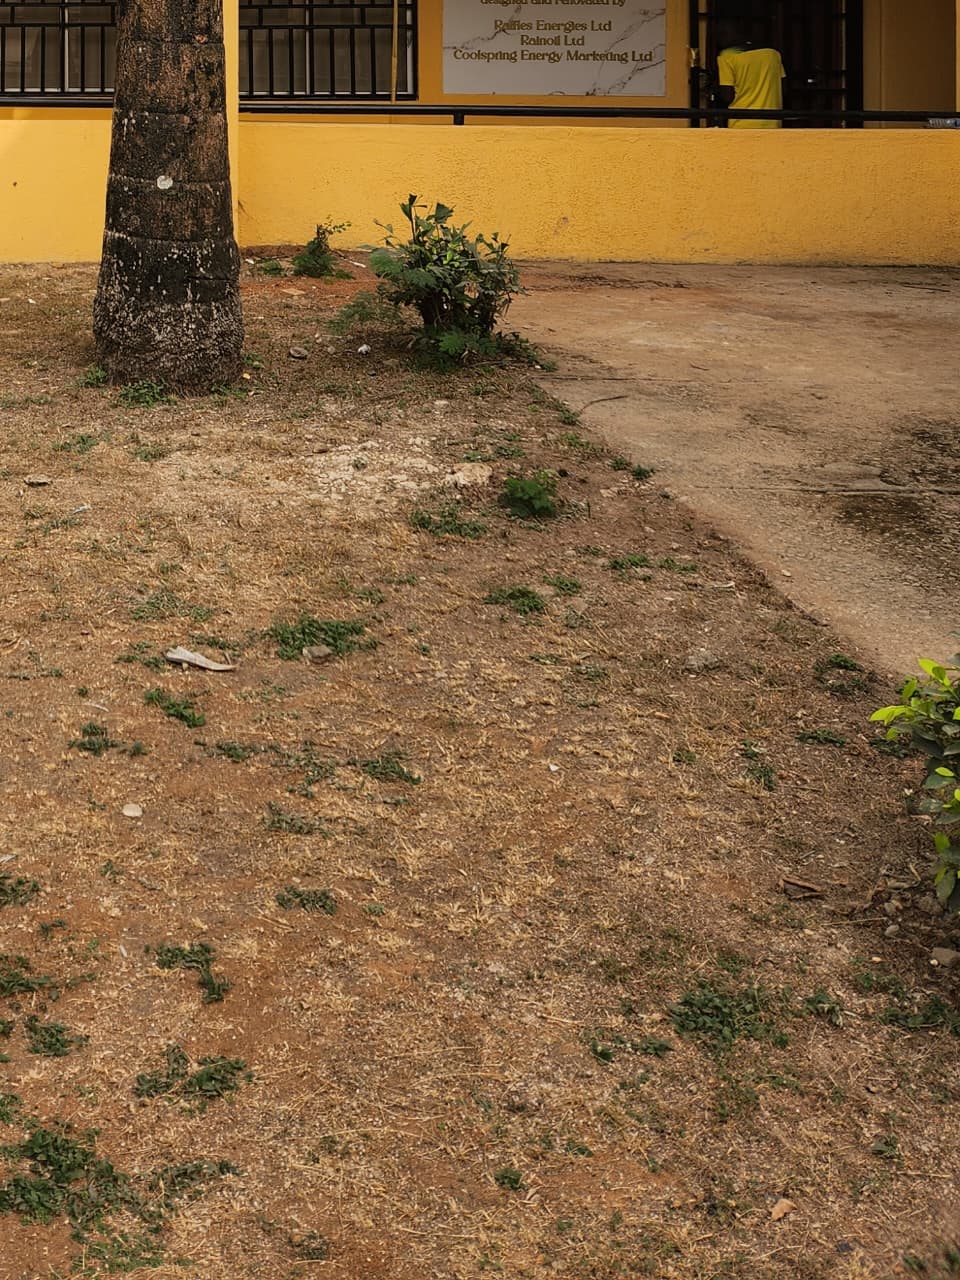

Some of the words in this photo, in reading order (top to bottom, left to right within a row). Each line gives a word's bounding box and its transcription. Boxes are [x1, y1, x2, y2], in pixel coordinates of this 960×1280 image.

[494, 19, 533, 31] Raffles
[536, 20, 587, 33] Energies
[591, 20, 612, 31] Ltd
[520, 35, 561, 46] Rainoil
[564, 35, 585, 46] Ltd
[454, 49, 517, 63] Coolspring
[520, 50, 563, 63] Energy
[566, 50, 628, 63] Marketing
[631, 50, 653, 61] Ltd
